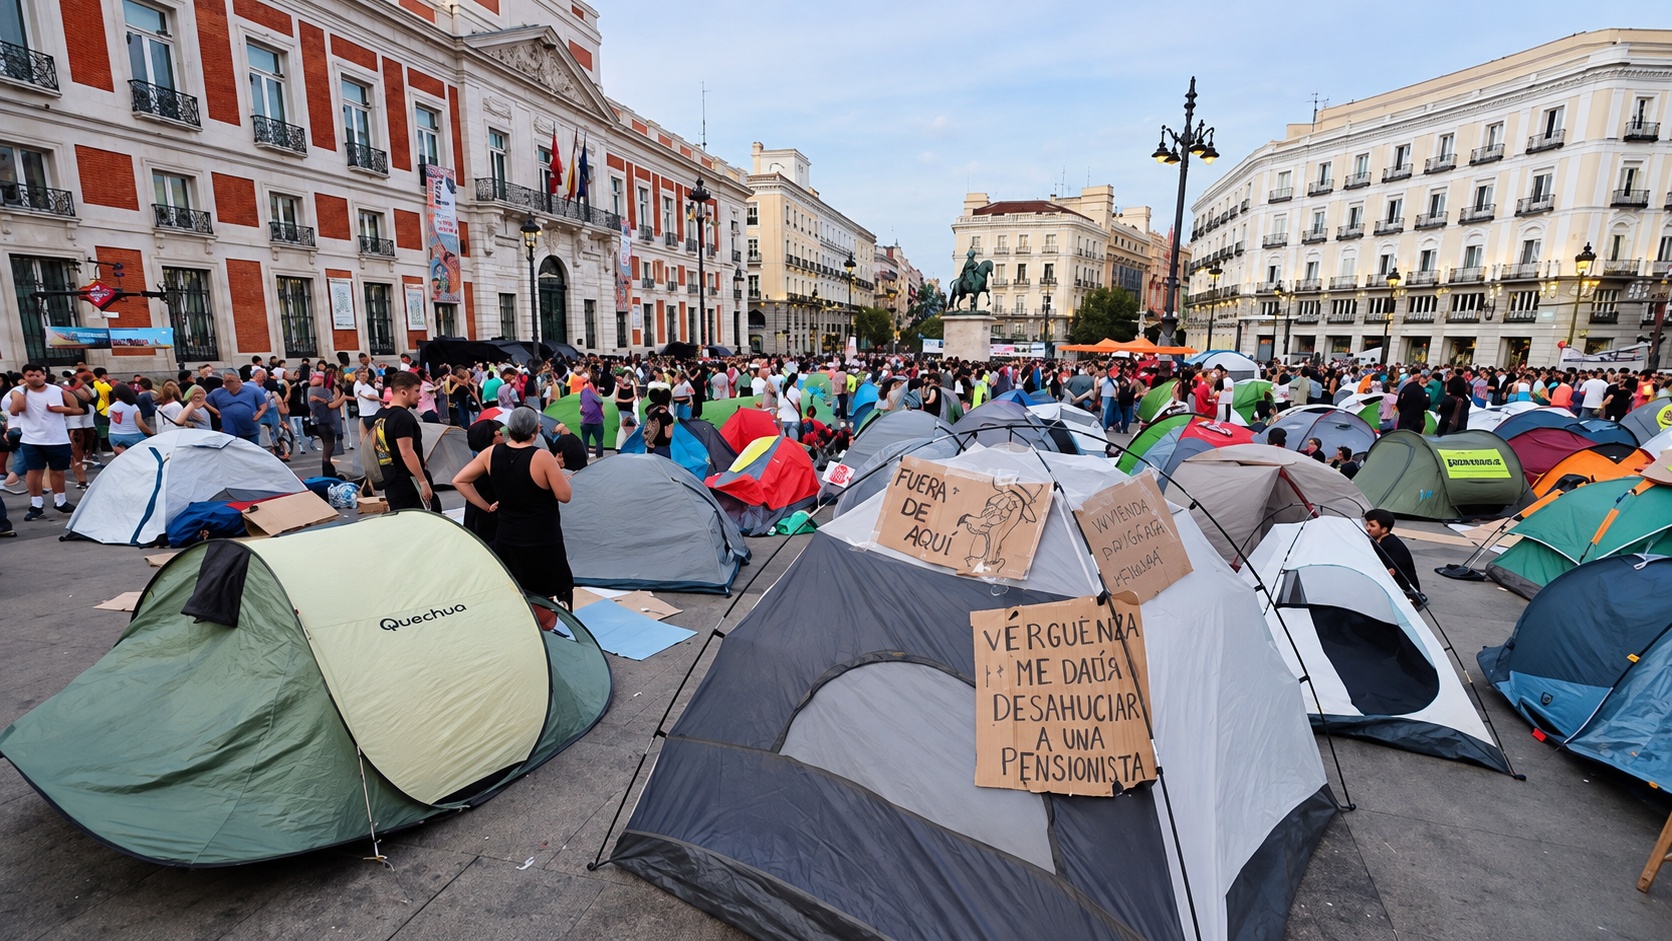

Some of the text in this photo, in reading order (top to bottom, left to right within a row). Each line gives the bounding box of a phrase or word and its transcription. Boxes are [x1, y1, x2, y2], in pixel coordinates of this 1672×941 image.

[895, 468, 947, 503] FUERA
[900, 497, 931, 523] DE
[903, 525, 958, 556] AQUÍ
[379, 603, 467, 632] Quechua
[1016, 658, 1052, 686] ME
[993, 693, 1140, 722] DESAHUCIAR
[1035, 726, 1105, 752] A UNA
[1001, 747, 1146, 783] PENSIONISTA
